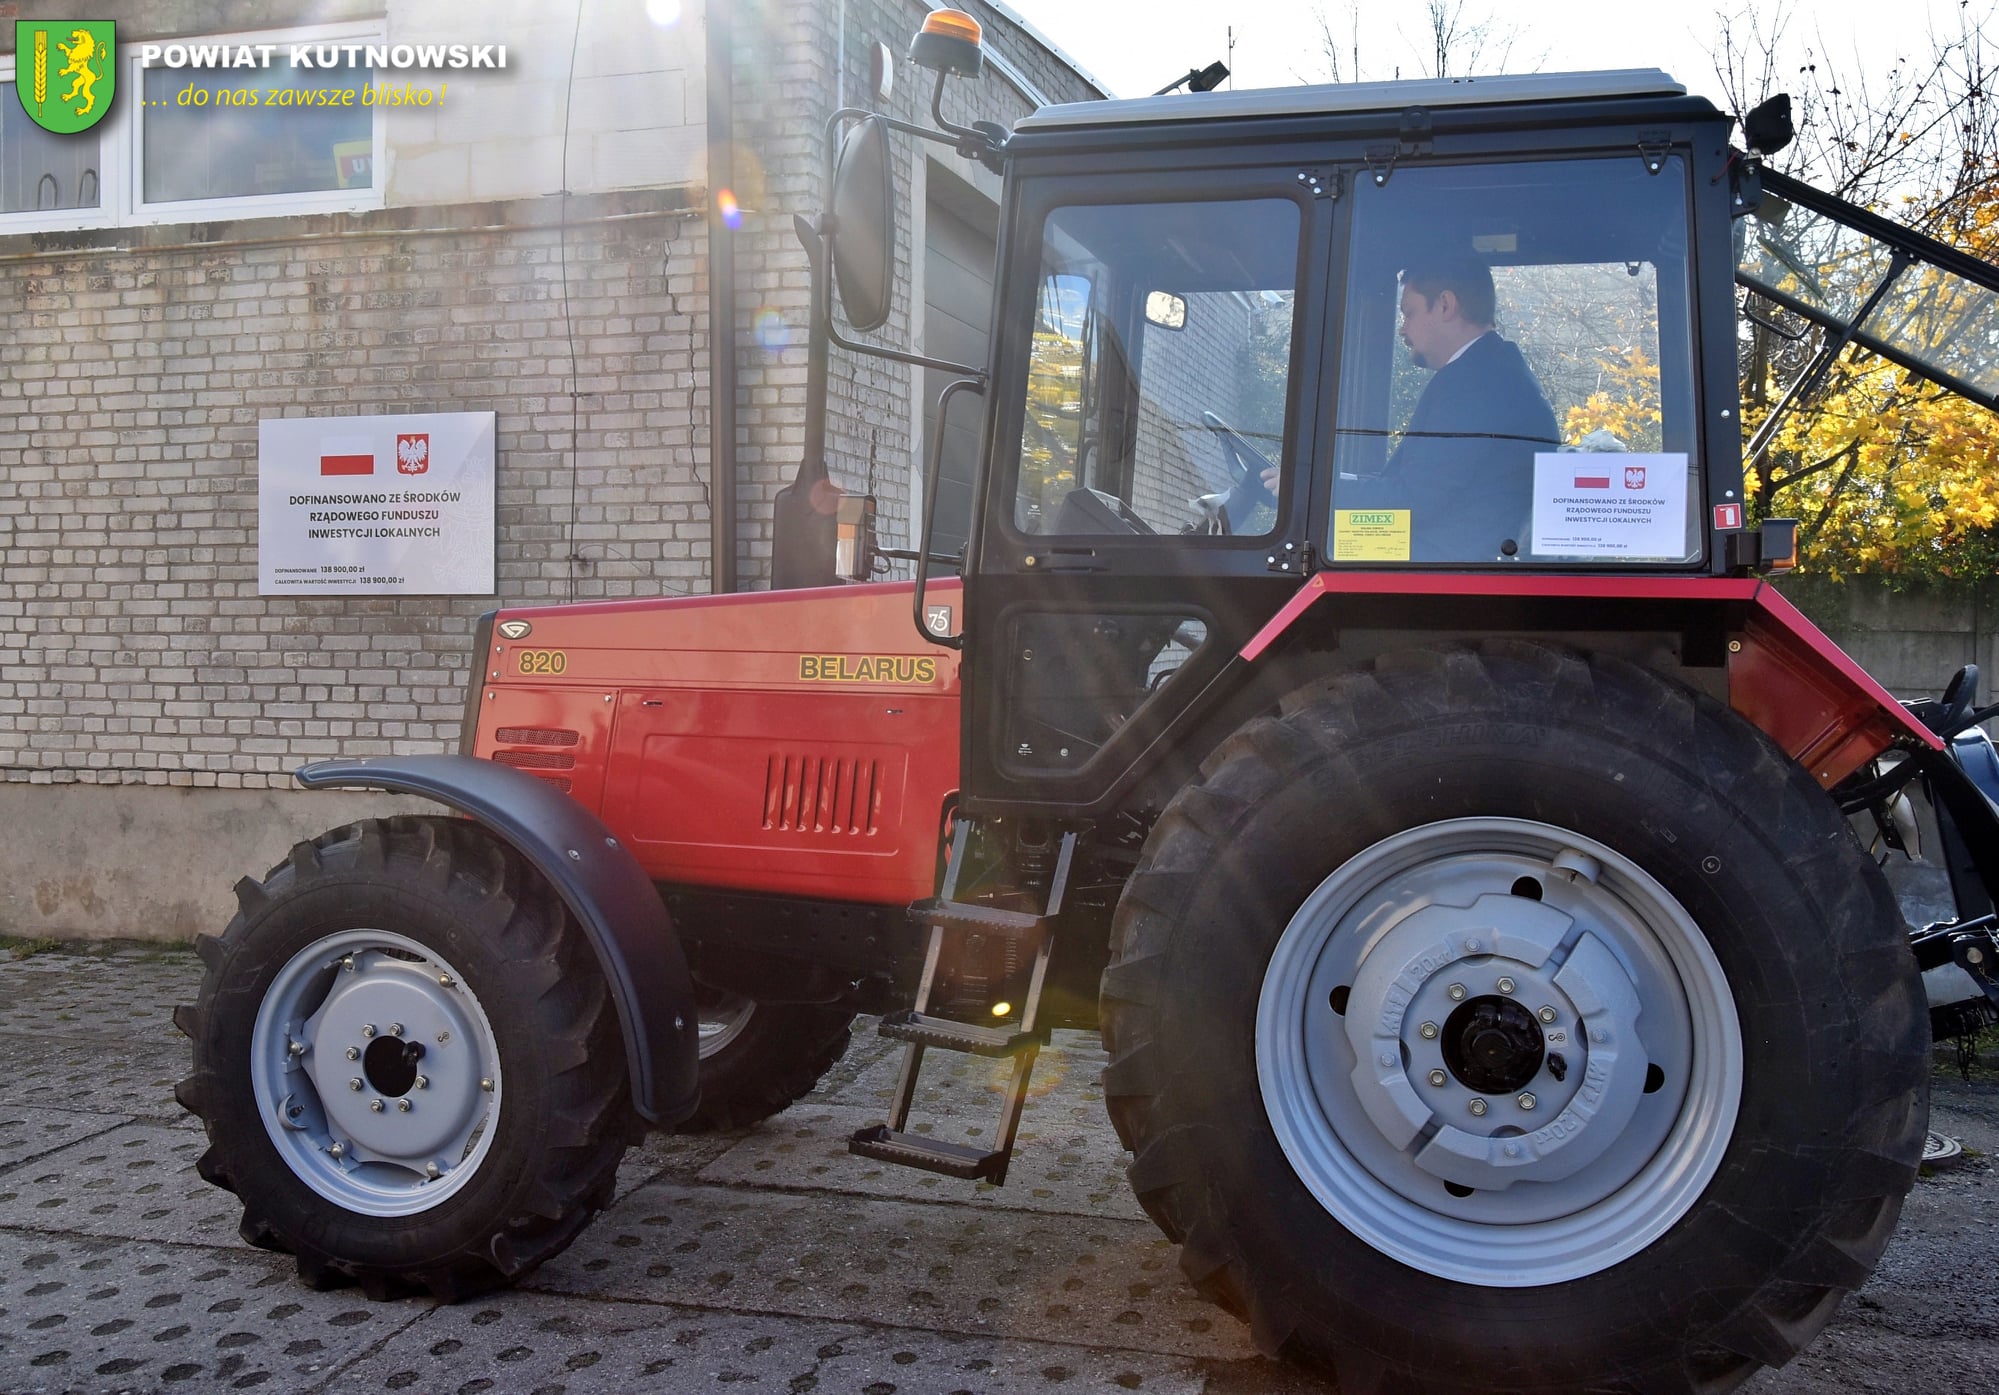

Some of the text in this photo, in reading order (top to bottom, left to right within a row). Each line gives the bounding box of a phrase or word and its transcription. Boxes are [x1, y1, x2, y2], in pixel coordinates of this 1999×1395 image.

[289, 490, 461, 505] DOFINANSOWANO ZE ŚRODKÓW
[1628, 498, 1666, 506] ŚRODKÓW
[309, 510, 439, 524] RZĄDOWEGO FUNDUSZU
[1352, 514, 1393, 524] ZIMEX
[308, 527, 440, 539] INWESTYCJI LOKALNYCH
[333, 566, 358, 574] 900,00
[372, 577, 397, 585] 900,00
[928, 610, 948, 631] 75
[519, 650, 566, 675] 820
[799, 655, 936, 683] BELARUS
